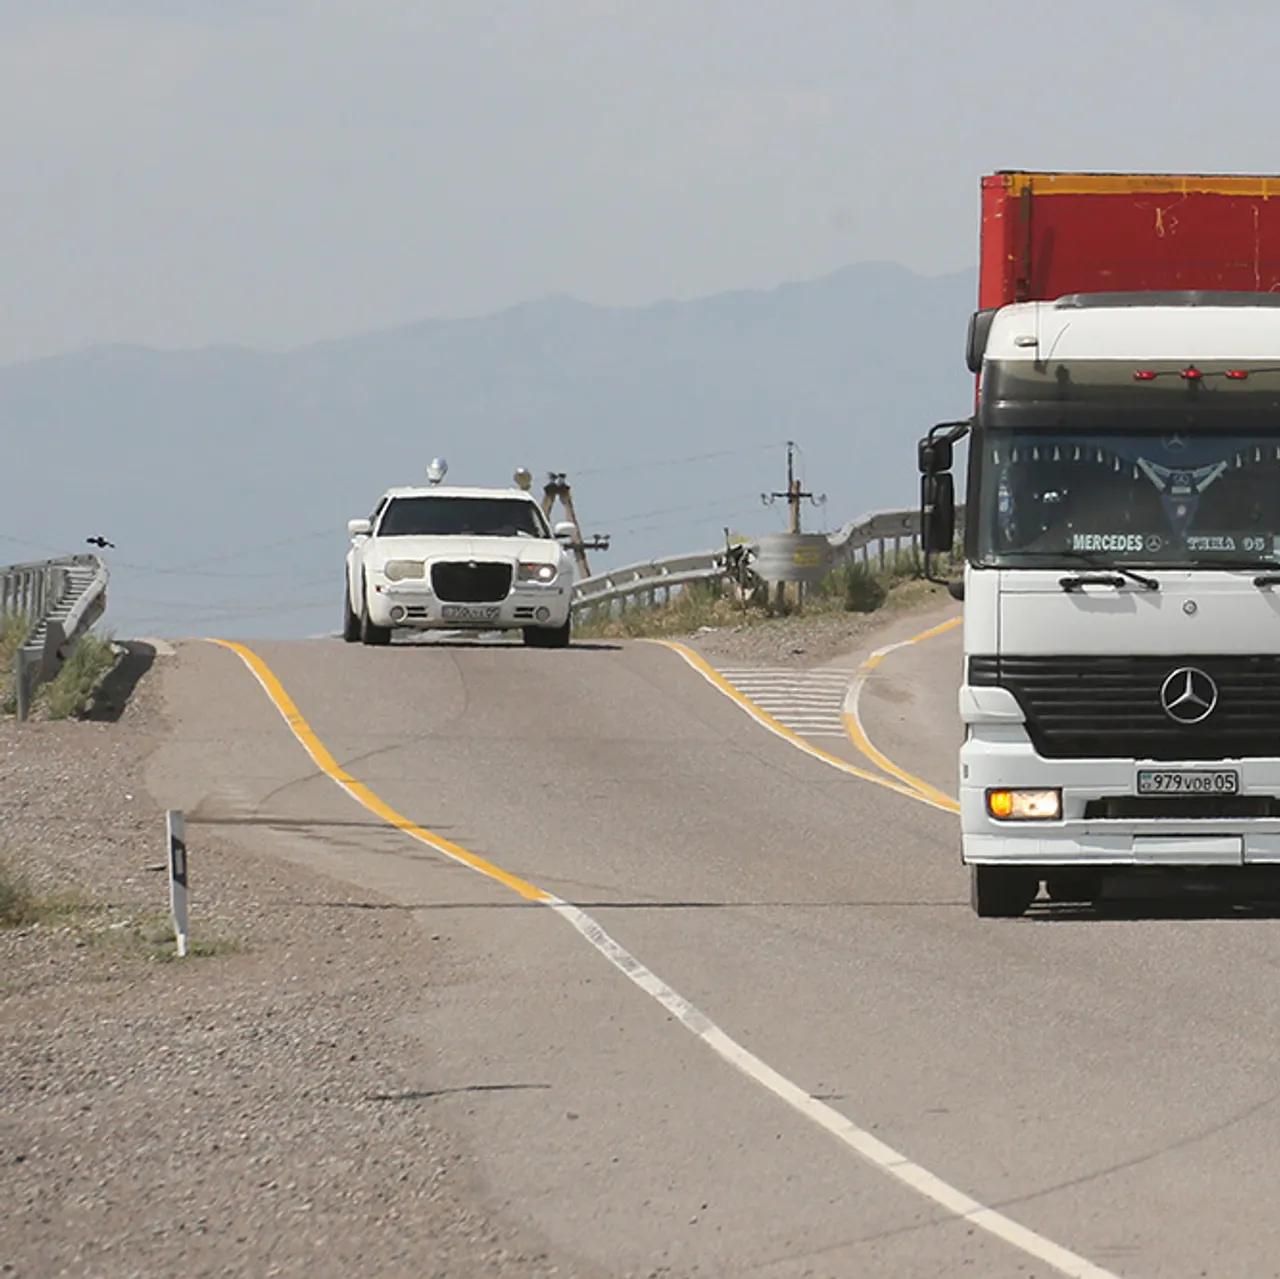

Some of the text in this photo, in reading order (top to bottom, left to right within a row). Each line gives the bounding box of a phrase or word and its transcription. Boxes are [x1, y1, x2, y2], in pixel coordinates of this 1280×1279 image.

[1072, 534, 1144, 551] MERCEDES
[1153, 773, 1183, 790] 979
[1214, 773, 1235, 790] 05
